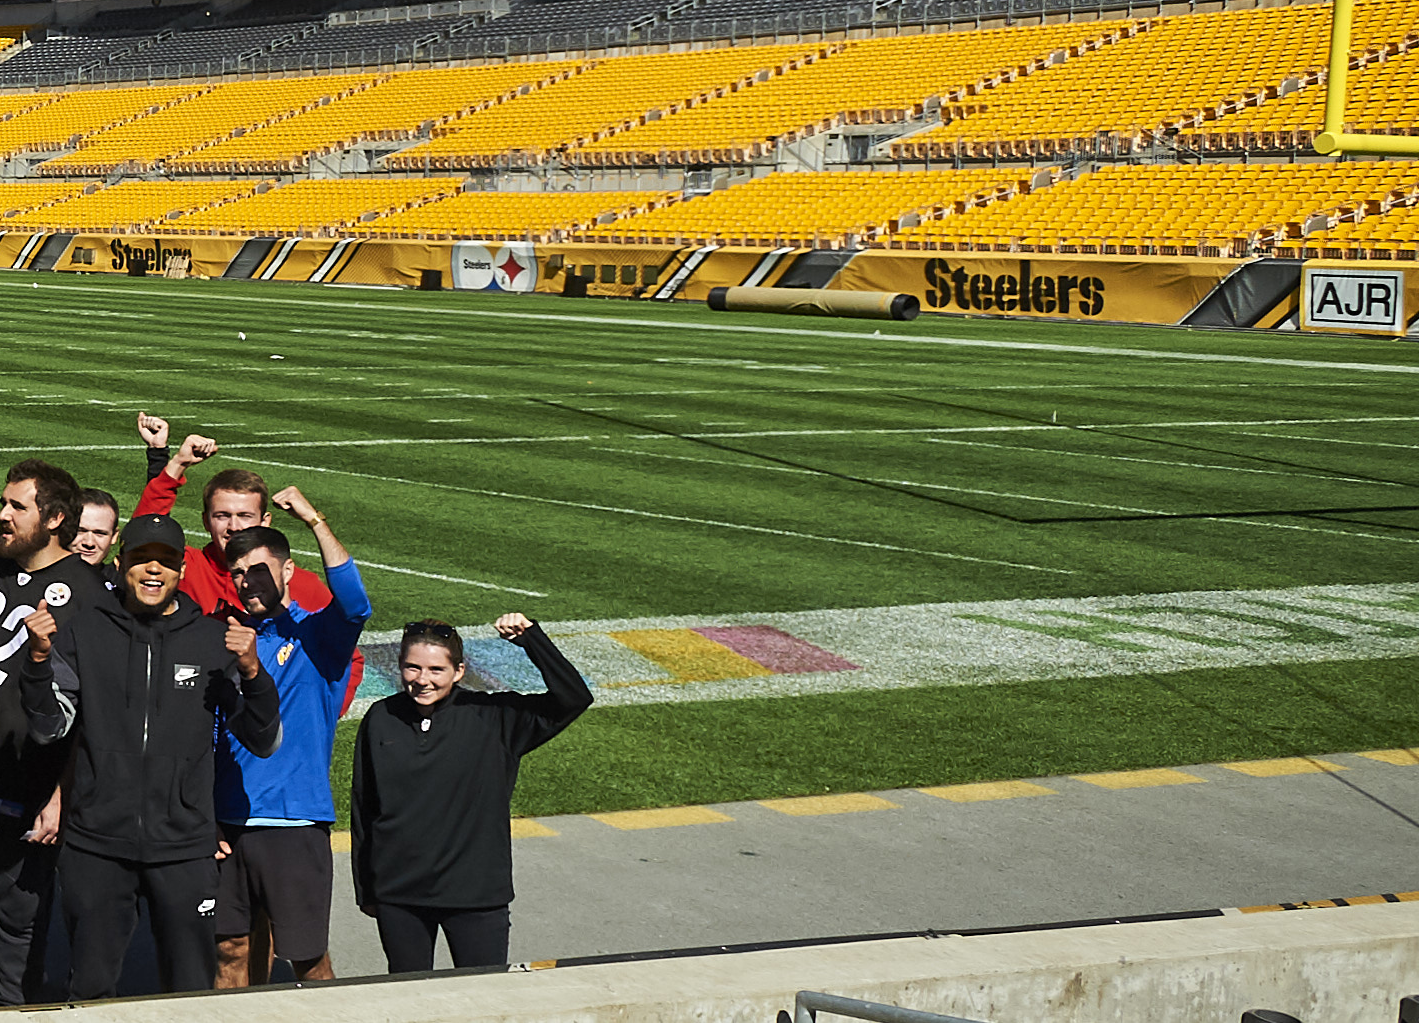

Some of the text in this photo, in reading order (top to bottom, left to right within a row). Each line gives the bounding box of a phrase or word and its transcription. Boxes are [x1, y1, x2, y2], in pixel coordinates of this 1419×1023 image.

[463, 258, 491, 270] Steelers
[925, 258, 1105, 316] Steelers
[1316, 281, 1391, 317] AJR
